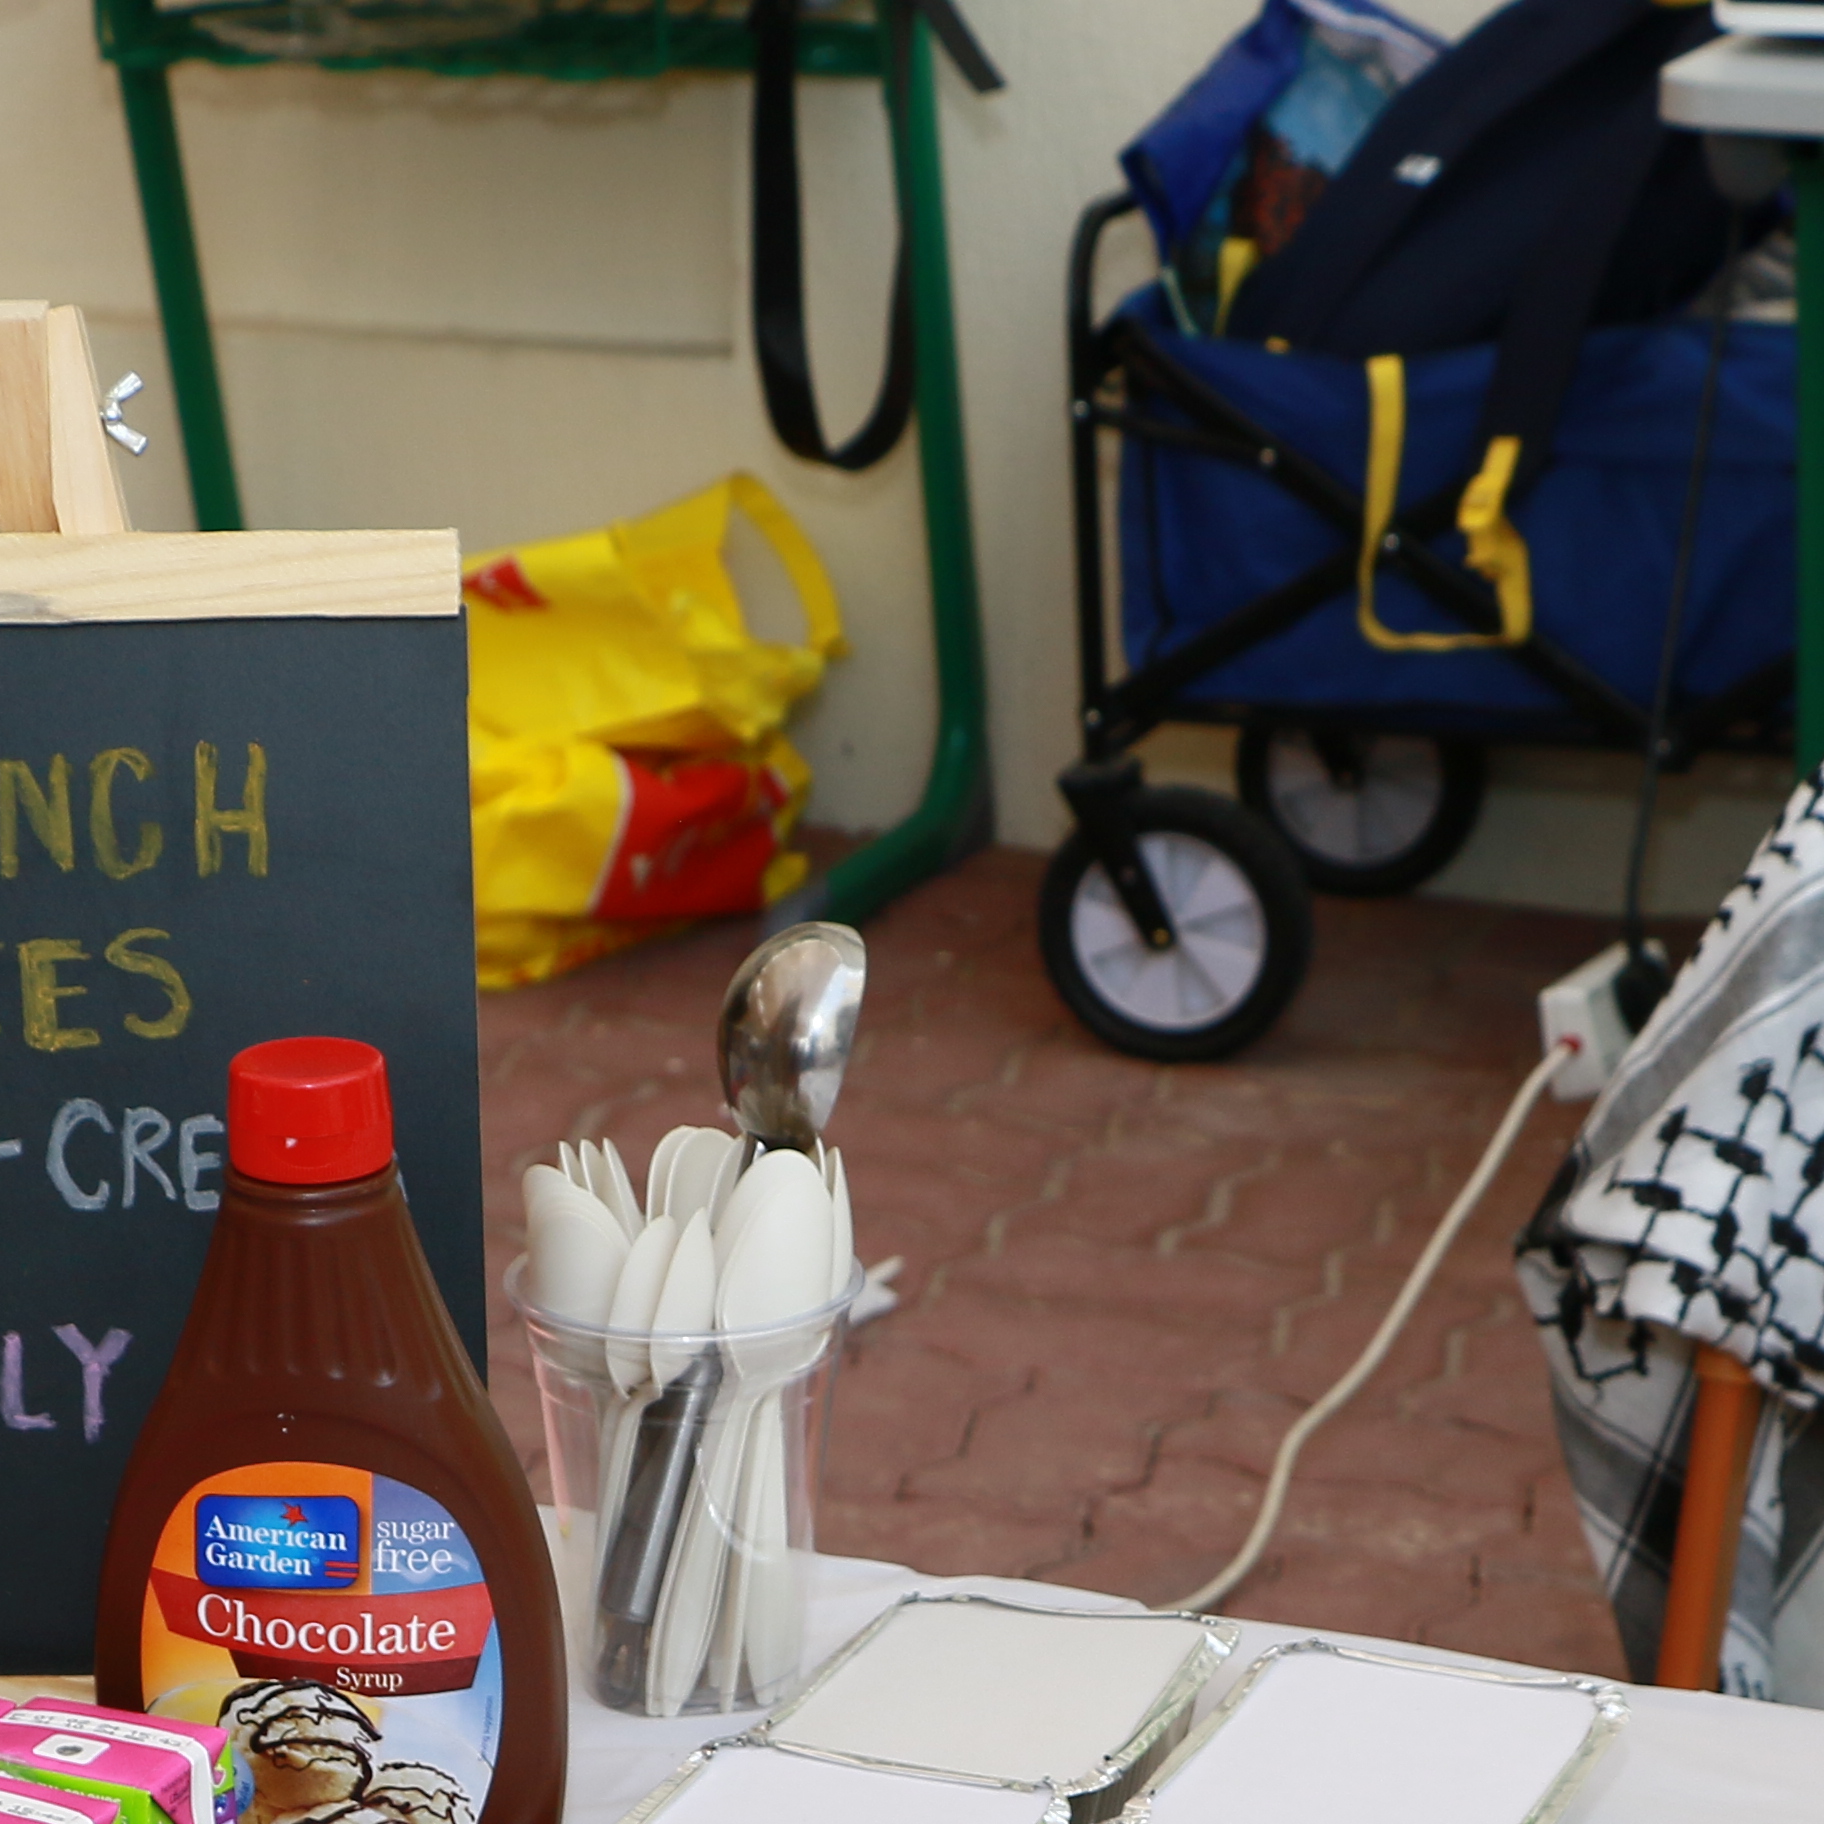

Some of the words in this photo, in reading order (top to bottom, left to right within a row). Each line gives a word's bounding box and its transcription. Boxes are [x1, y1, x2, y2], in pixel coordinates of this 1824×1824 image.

[205, 1514, 348, 1551] American
[377, 1520, 455, 1545] sugar
[205, 1542, 313, 1576] Garden
[373, 1539, 453, 1574] free
[196, 1593, 457, 1655] Chocolate
[336, 1666, 404, 1692] Syrup
